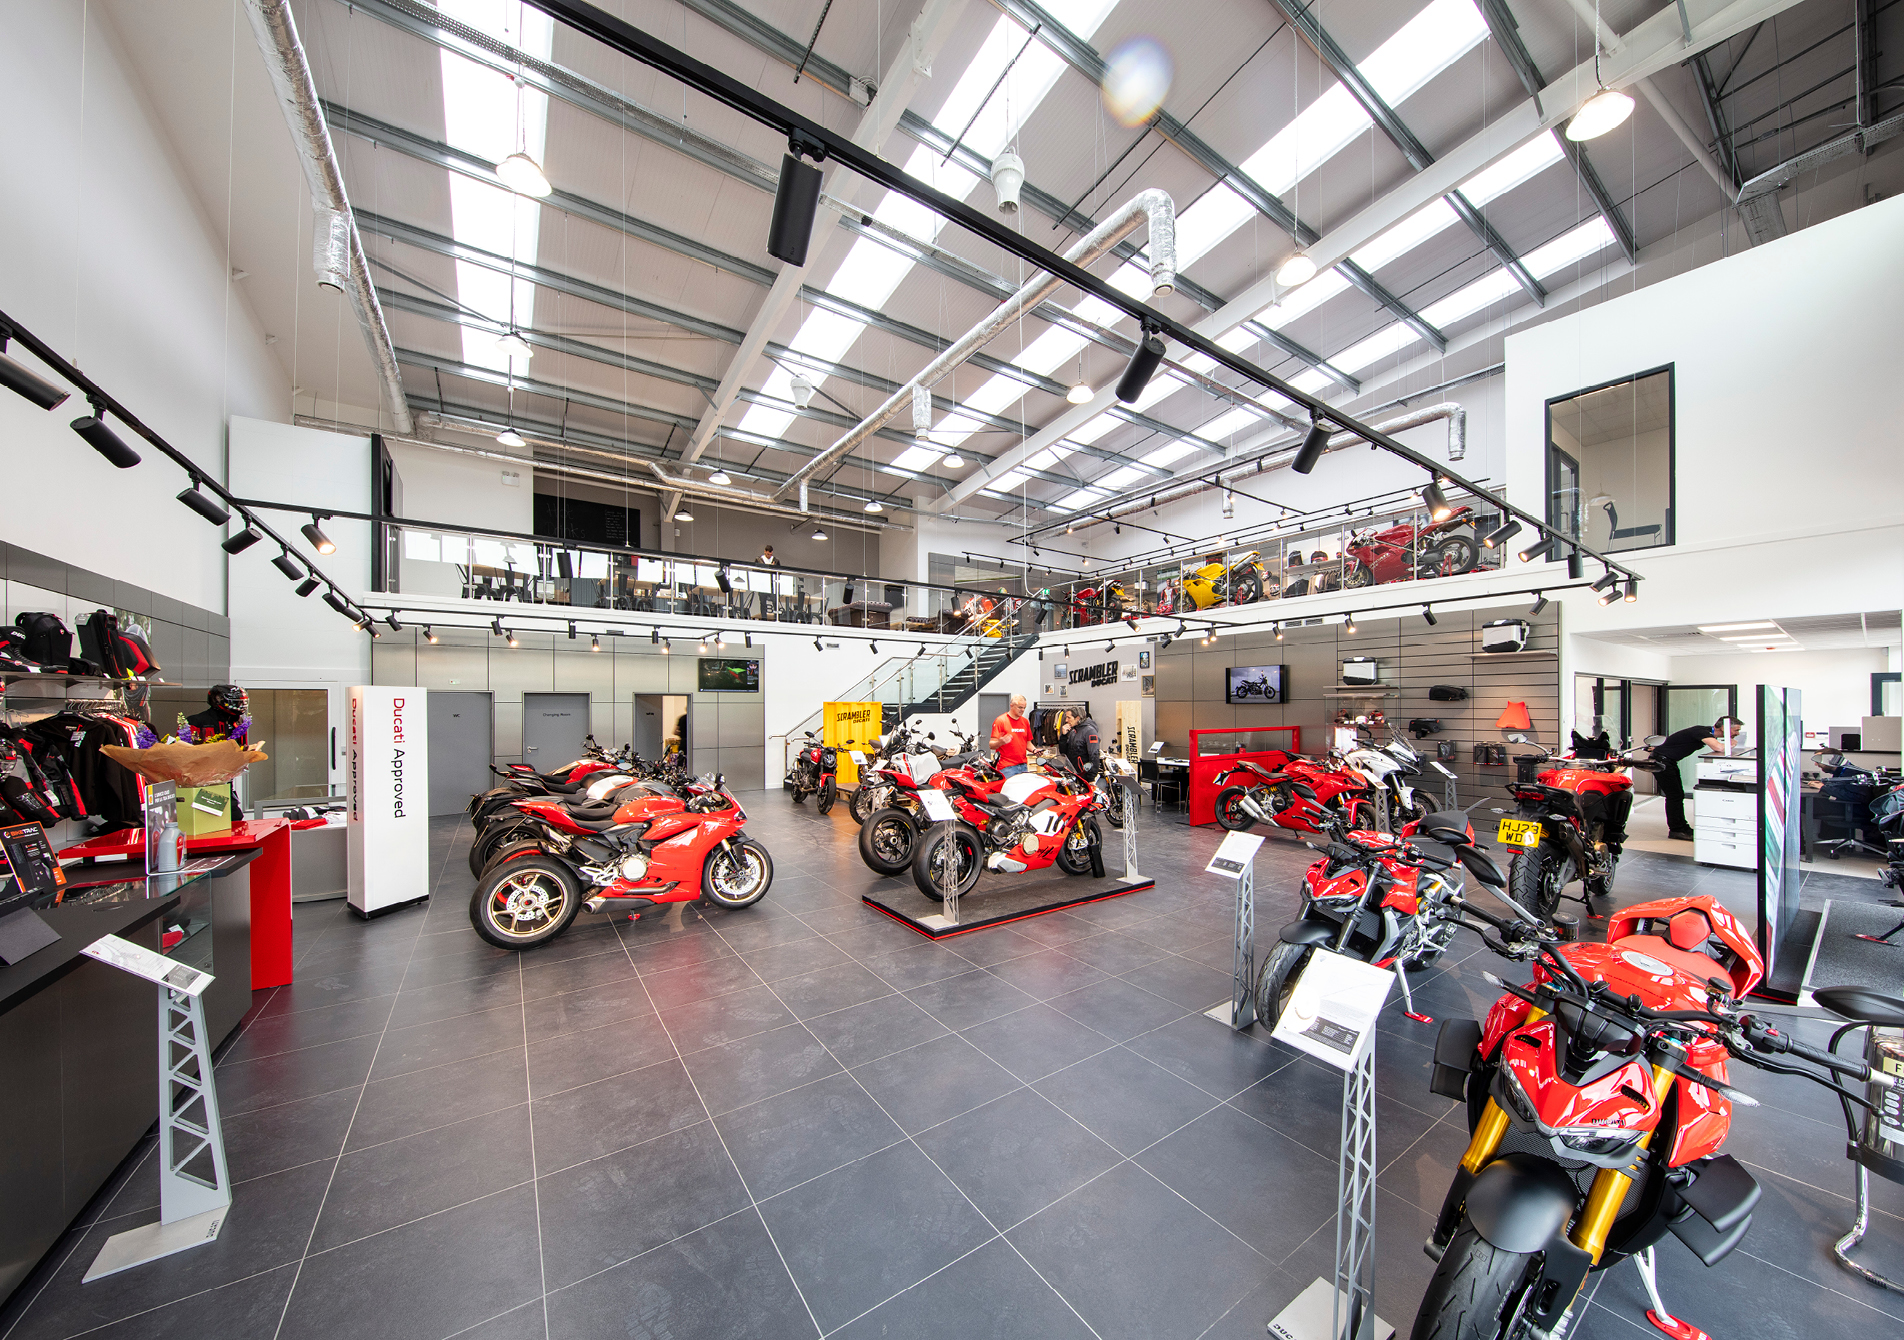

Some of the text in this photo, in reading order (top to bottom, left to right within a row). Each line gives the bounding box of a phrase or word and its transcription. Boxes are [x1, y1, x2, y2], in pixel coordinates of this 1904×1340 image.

[1068, 660, 1119, 685] SCRAMBLER
[1091, 675, 1118, 688] DUCATI
[836, 709, 871, 722] SCRAMBLER
[1127, 726, 1139, 765] SCRAMBLER
[390, 698, 407, 819] Ducati Approved
[1502, 821, 1540, 835] HJ23
[1591, 1118, 1625, 1126] DUCATI
[1273, 1323, 1298, 1340] DUC
